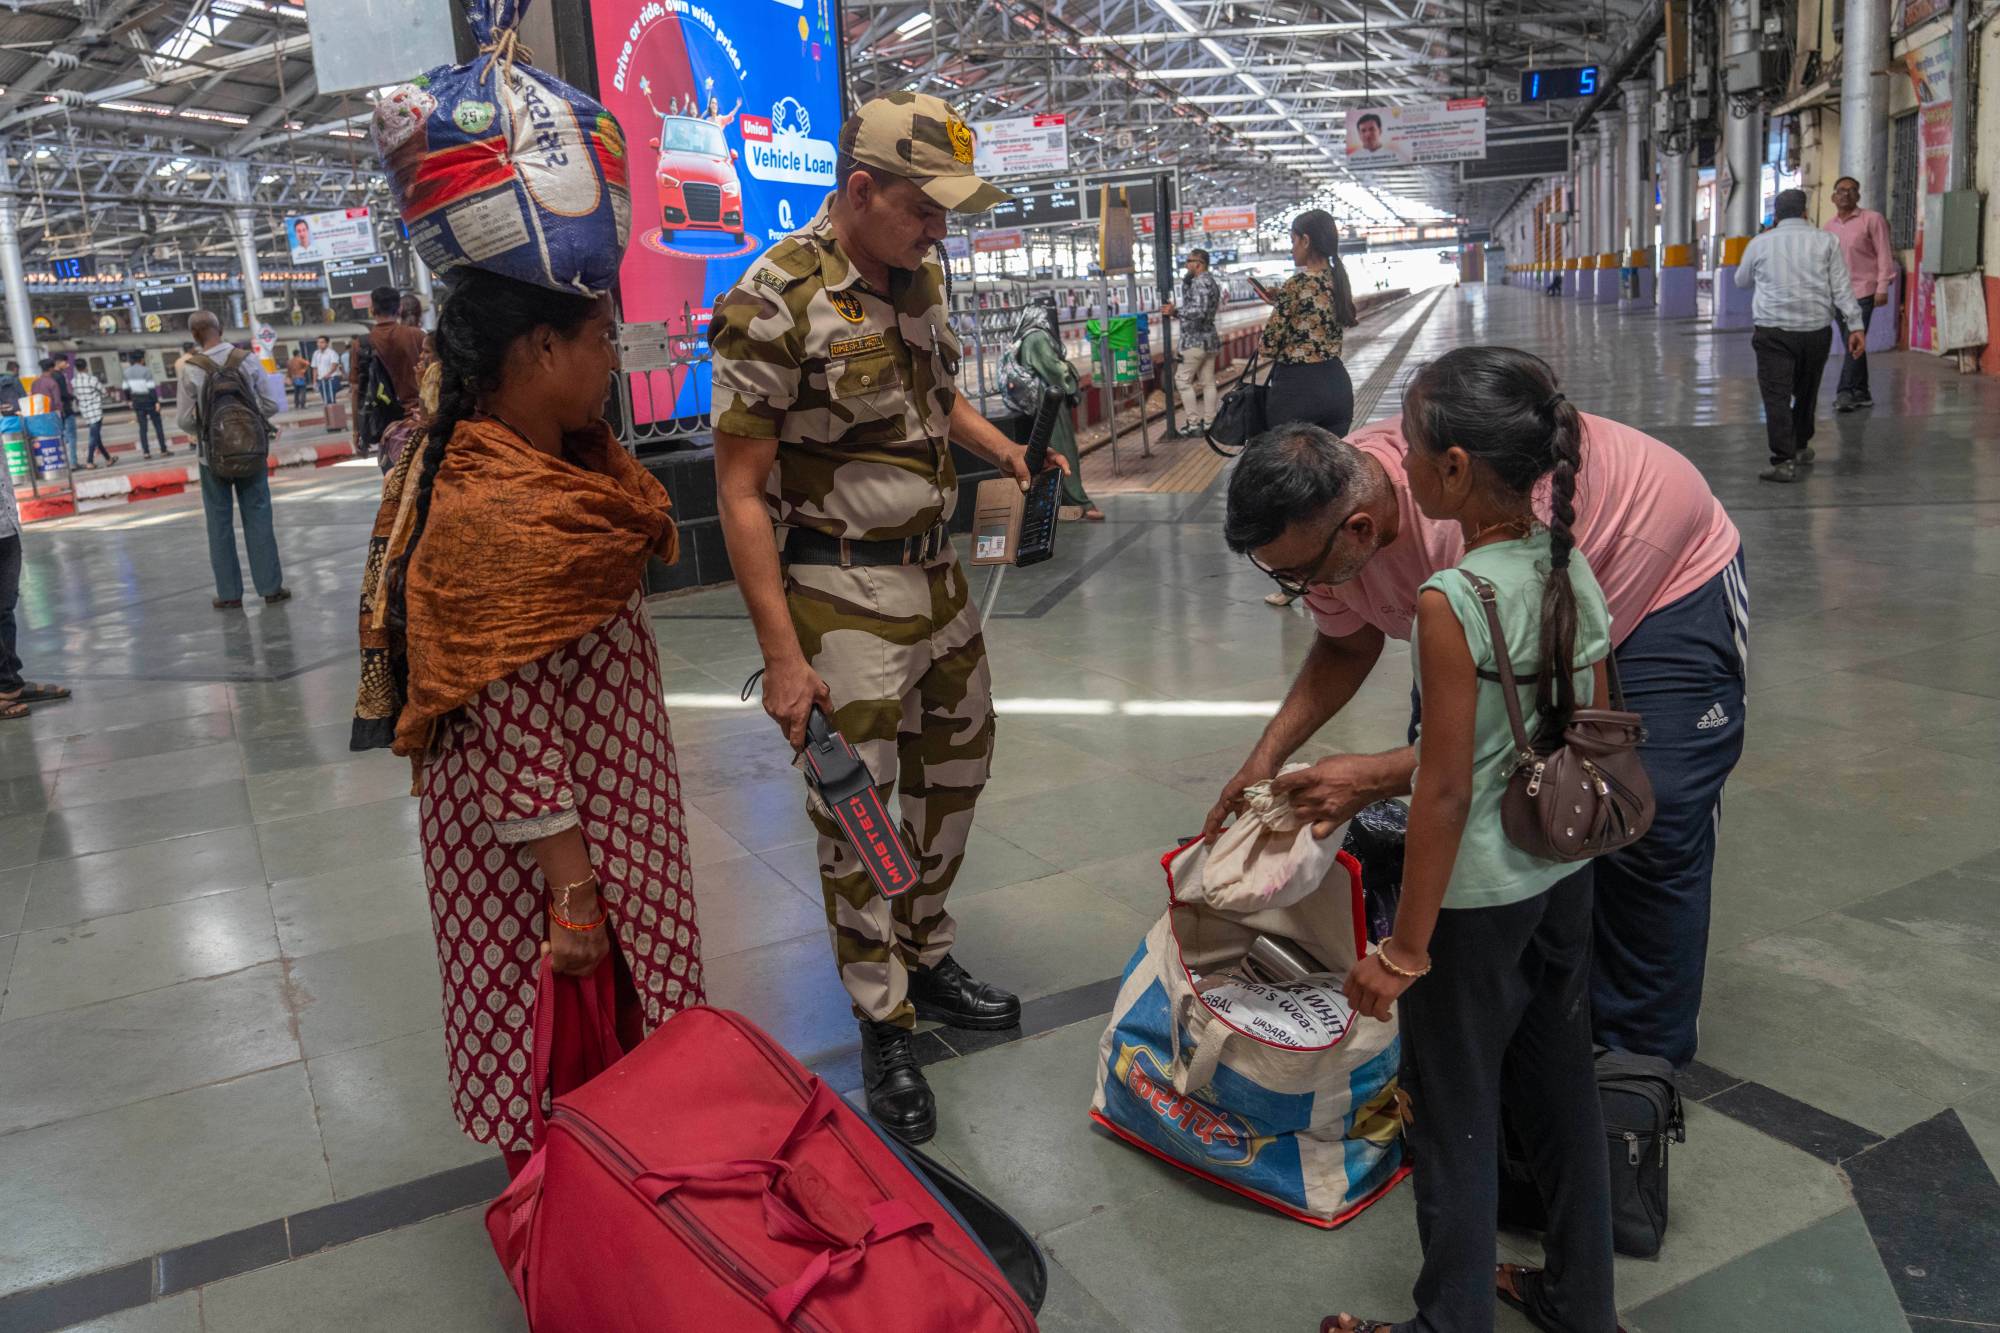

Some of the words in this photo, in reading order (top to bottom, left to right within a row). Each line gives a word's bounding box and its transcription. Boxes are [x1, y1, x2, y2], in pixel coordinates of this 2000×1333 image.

[613, 40, 633, 92] Drive
[629, 20, 641, 41] or
[640, 2, 665, 27] ride,
[665, 0, 690, 14] own
[691, 5, 716, 32] with
[716, 28, 741, 70] pride
[1580, 68, 1596, 94] 5
[1506, 89, 1518, 102] 6
[461, 110, 478, 126] 25
[743, 120, 769, 137] Union
[752, 146, 801, 171] Vehicle
[804, 153, 834, 175] Loan
[1696, 716, 1729, 729] adidas
